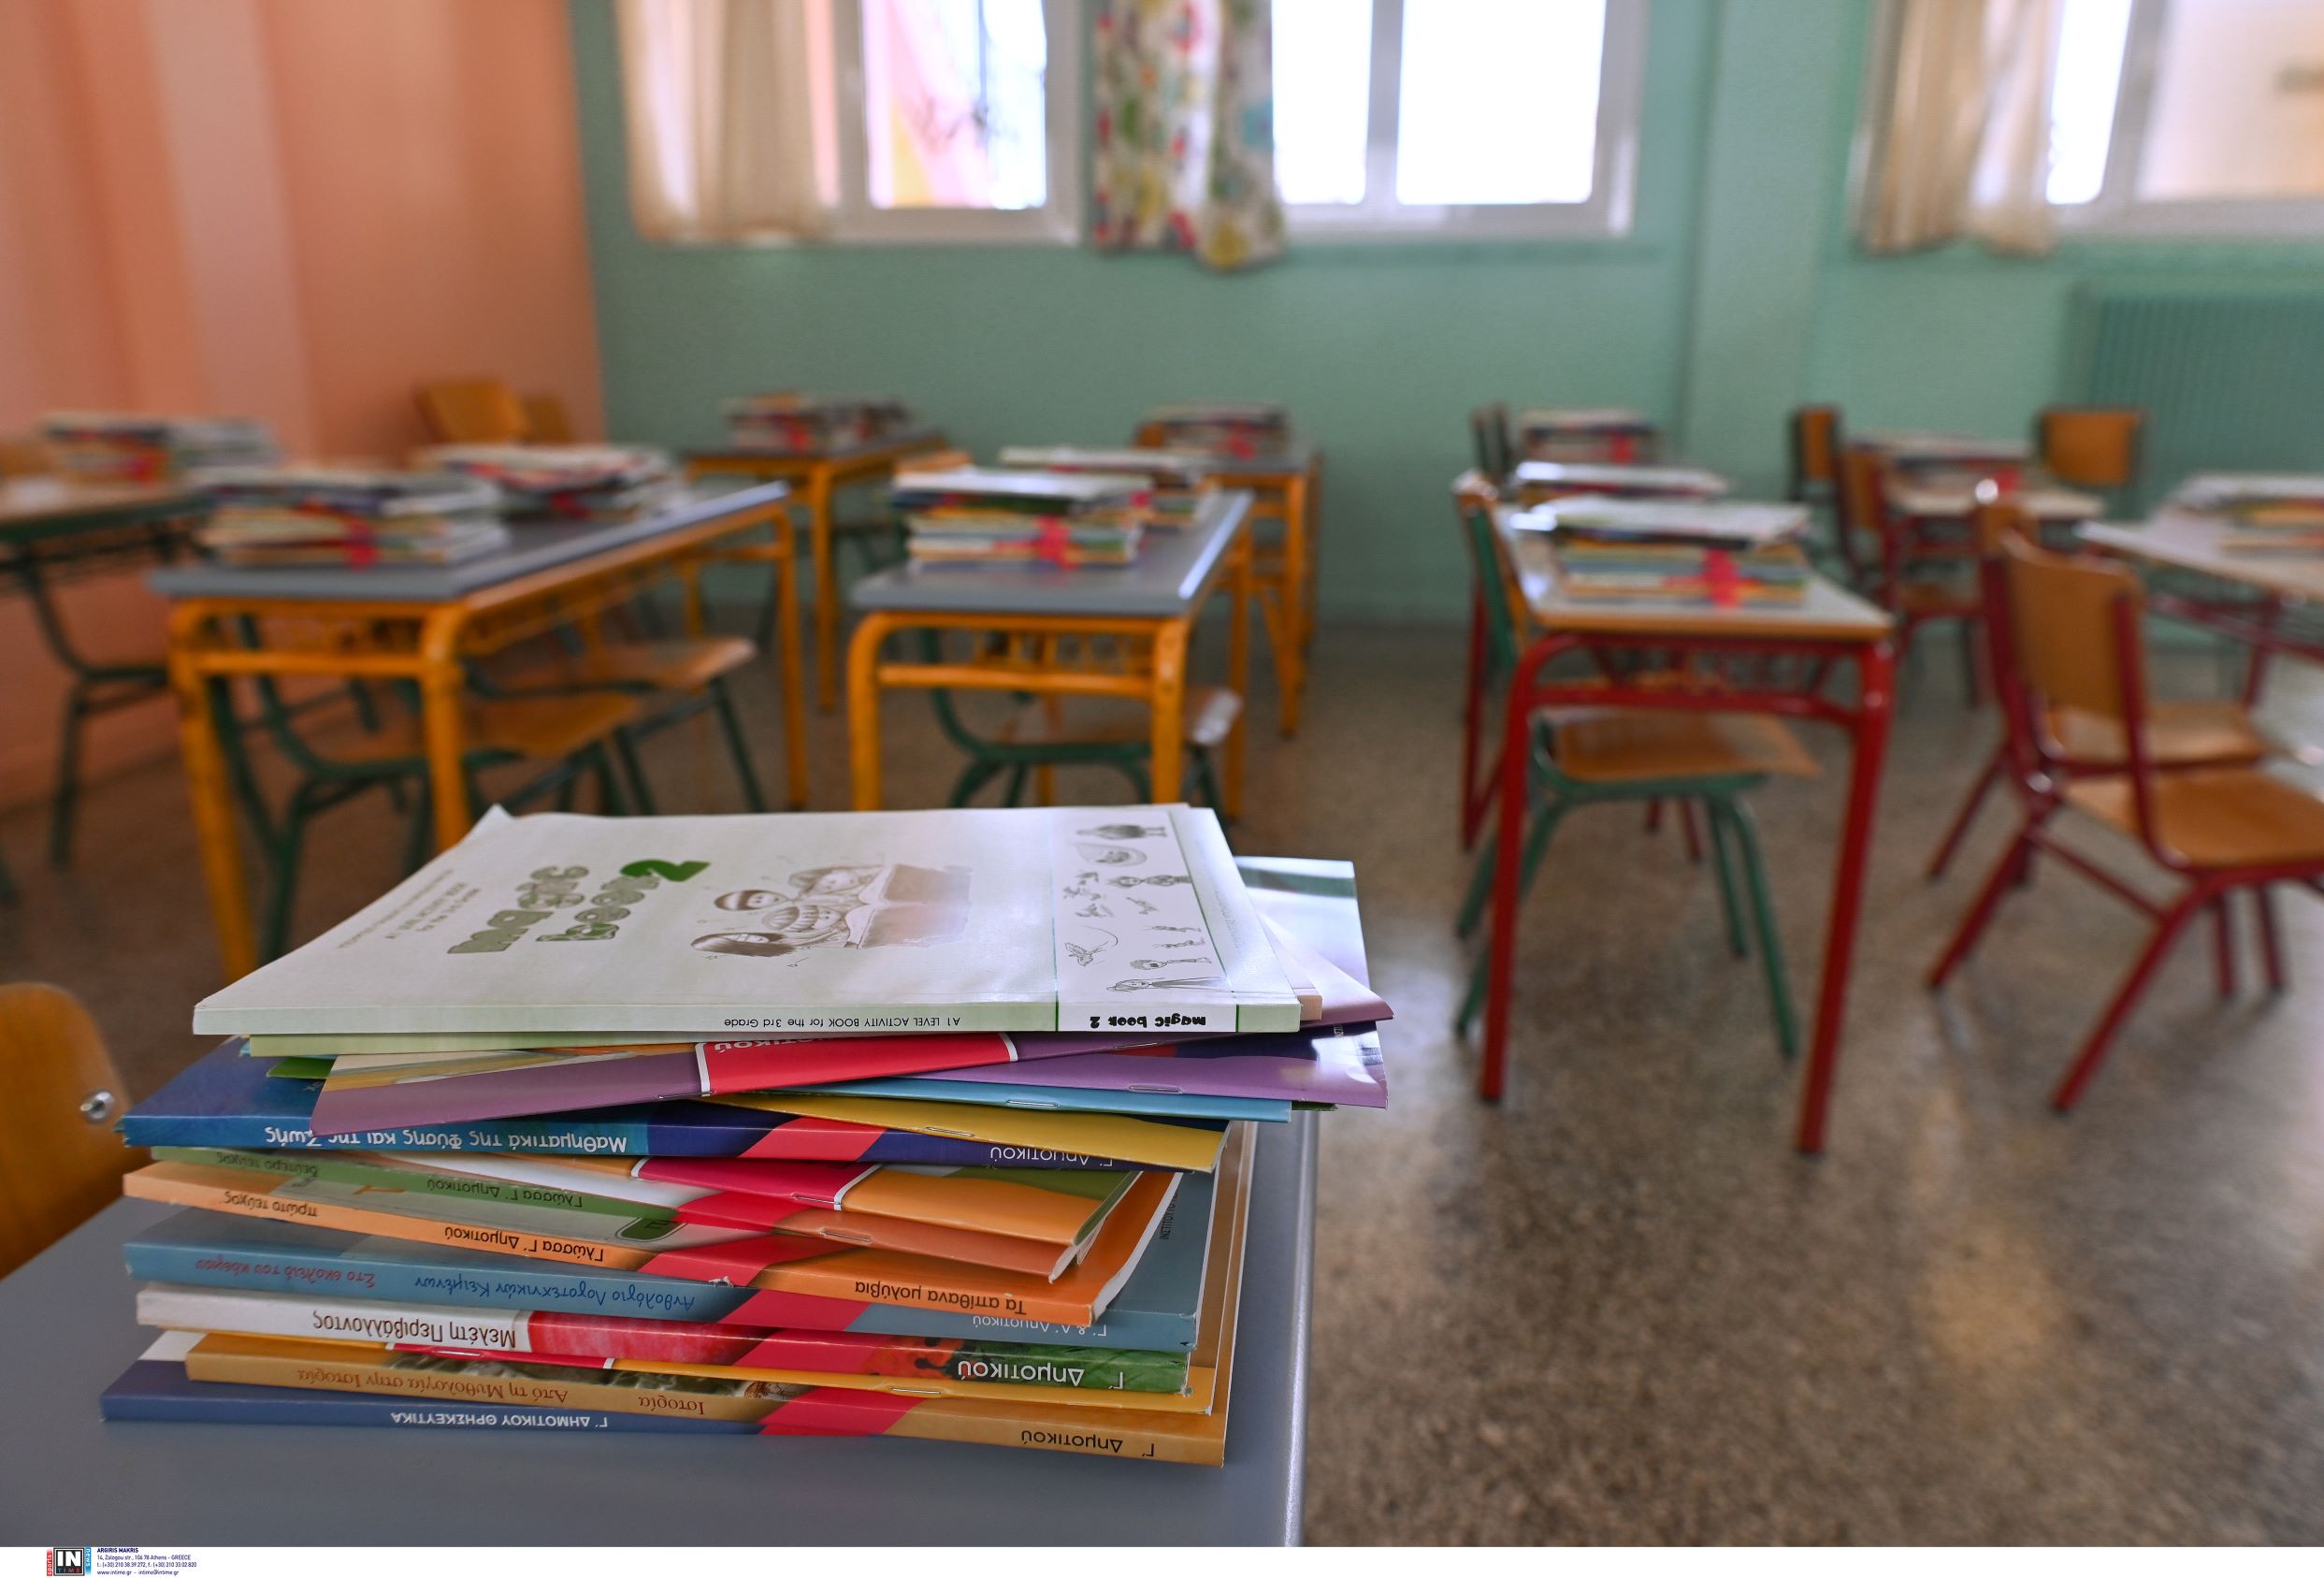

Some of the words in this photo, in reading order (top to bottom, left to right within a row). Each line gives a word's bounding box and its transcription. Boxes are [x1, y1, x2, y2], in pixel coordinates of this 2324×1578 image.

[619, 859, 711, 882] 2
[724, 1018, 758, 1028] Grade
[763, 1018, 782, 1028] 3rd
[787, 1018, 804, 1027] the
[810, 1018, 823, 1027] for
[829, 1018, 859, 1027] BOOK
[864, 1017, 909, 1027] ACTIVITY
[913, 1017, 940, 1027] LEVEL
[947, 1017, 960, 1027] A1
[1090, 1016, 1101, 1029] 2
[1107, 1015, 1148, 1028] book
[1154, 1013, 1206, 1028] magic
[265, 1127, 322, 1149] Ζωής
[367, 1133, 397, 1145] και
[403, 1130, 463, 1150] Φύσης
[469, 1131, 502, 1148] της
[508, 1133, 628, 1153] Μαθηματικά
[427, 1180, 500, 1197] Δημοτικού
[224, 1192, 268, 1210] τεύχος
[524, 1191, 583, 1208] Γλώσσα
[272, 1201, 318, 1217] πρώτο
[445, 1227, 520, 1250] Δημοτικού
[543, 1241, 604, 1262] Γλώσσα
[347, 1271, 374, 1288] Στο
[414, 1274, 490, 1297] Κειμένων
[496, 1281, 607, 1306] Λογοτεχνικών
[613, 1284, 696, 1310] Ανθολόγιο
[855, 1281, 922, 1301] μολύβια
[927, 1290, 1000, 1310] απίθανα
[1005, 1299, 1028, 1316] Τα
[313, 1310, 443, 1343] Περιβάλλοντος
[450, 1322, 516, 1349] Μελέτη
[297, 1368, 360, 1388] Ιστορία
[367, 1372, 403, 1388] στην
[958, 1360, 1085, 1387] Δημοτικού
[408, 1376, 504, 1400] Μυθολογία
[509, 1382, 526, 1399] τη
[533, 1387, 569, 1404] Από
[639, 1395, 704, 1415] Ιστορία
[390, 1412, 498, 1426] ΘΡΗΣΚΕΥΤΙΚΑ
[502, 1414, 591, 1427] ΔΗΜΟΤΙΚΟΥ
[1020, 1429, 1123, 1454] Δημοτικού
